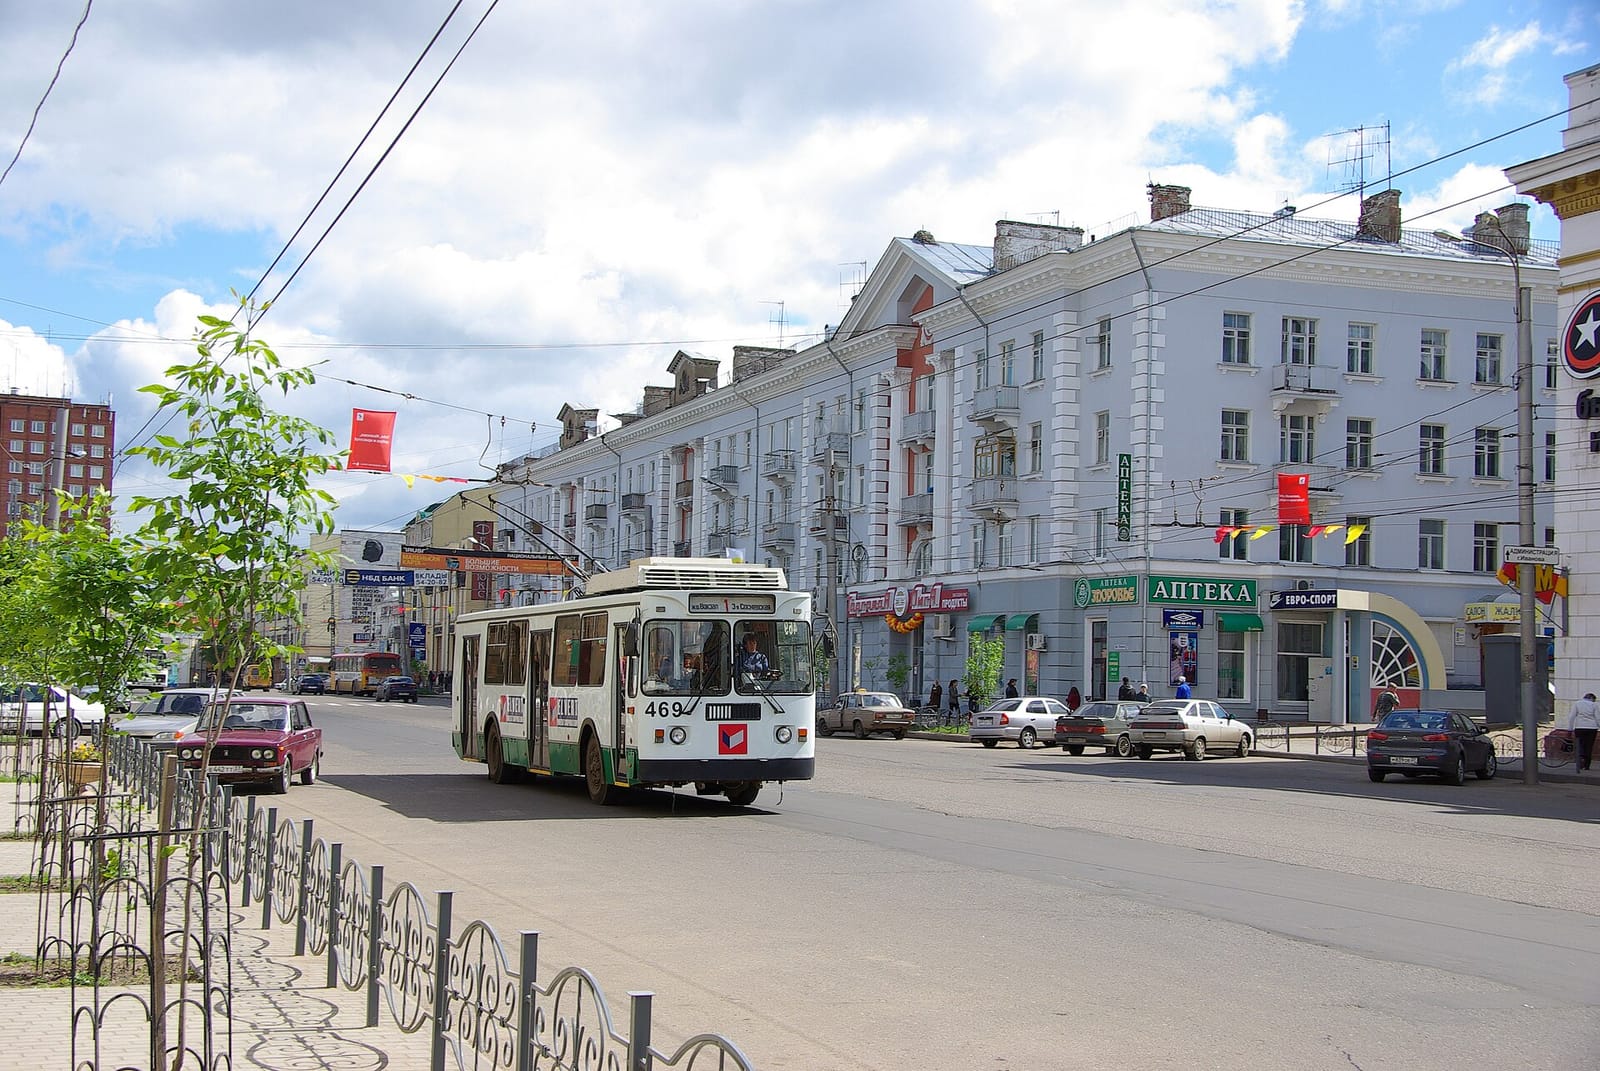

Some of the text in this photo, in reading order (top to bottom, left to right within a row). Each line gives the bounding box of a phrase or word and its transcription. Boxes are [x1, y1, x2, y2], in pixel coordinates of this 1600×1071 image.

[1119, 456, 1130, 524] АПТЕКА
[1509, 548, 1558, 556] АДМИНИСТРАЦИЯ
[464, 558, 500, 566] БОЛЬШИЕ
[464, 564, 520, 572] ВОЗМОЖНОСТИ
[361, 574, 406, 582] НБД БАНК
[415, 572, 448, 580] ВКЛАДЫ
[1100, 578, 1128, 587] АПТЕКА
[1152, 580, 1253, 602] АПТЕКА
[941, 598, 968, 610] ПРОДУКТЫ
[1285, 593, 1337, 606] ЕВРО-СПОРТ
[1466, 606, 1486, 616] САЛОН
[645, 701, 683, 718] 469
